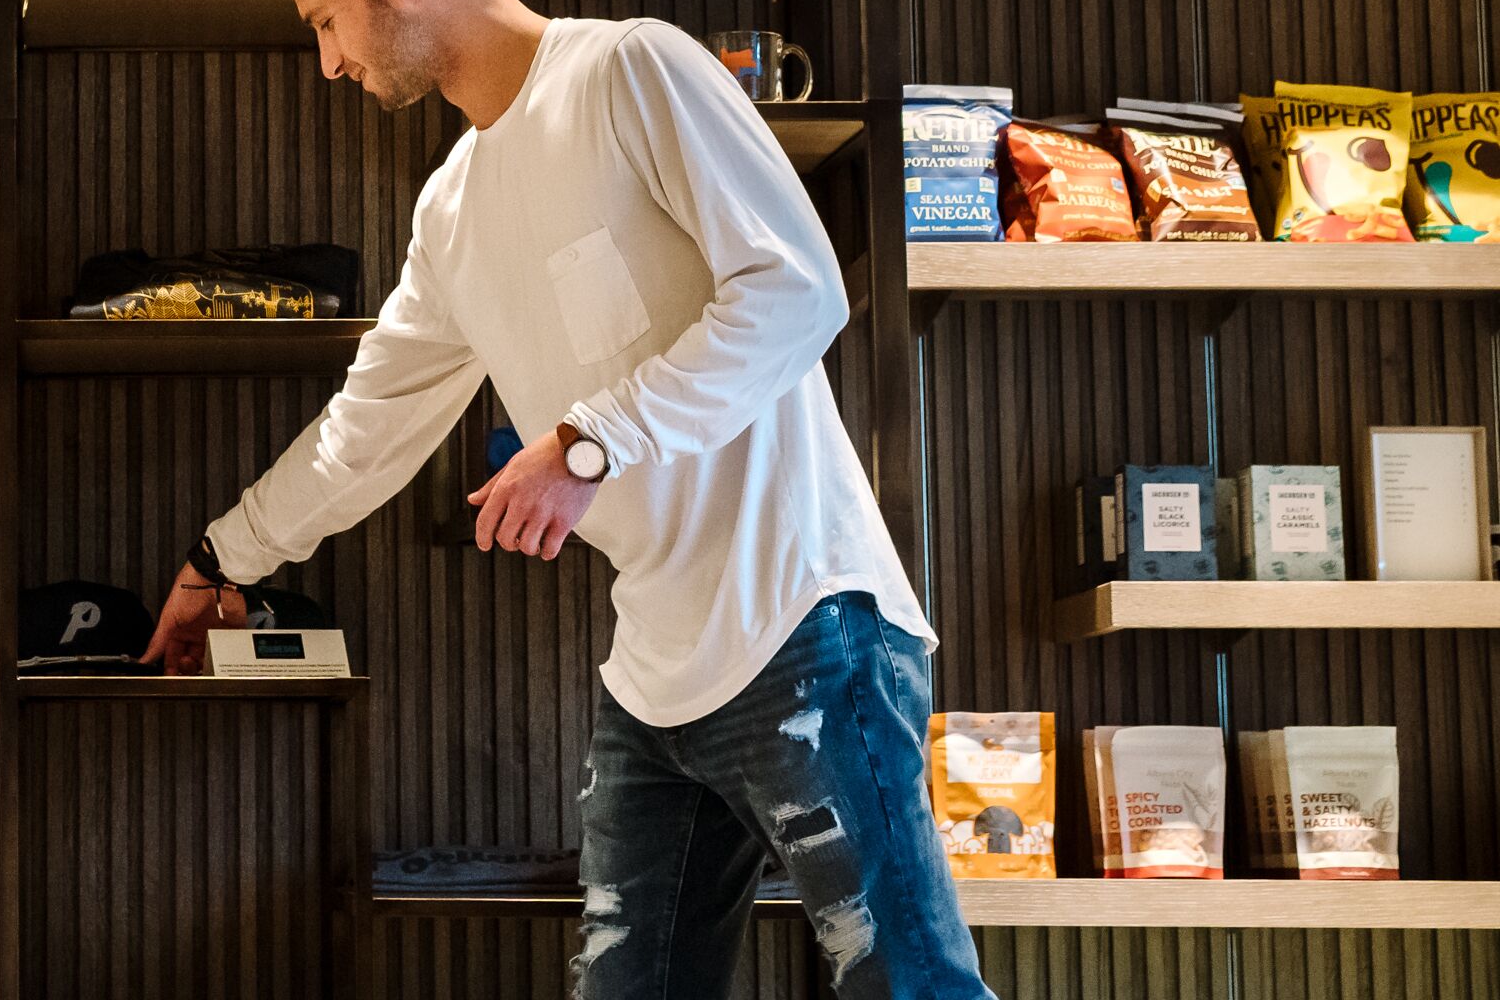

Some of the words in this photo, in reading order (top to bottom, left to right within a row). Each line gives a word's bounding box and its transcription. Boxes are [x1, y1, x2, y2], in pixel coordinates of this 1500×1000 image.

[1278, 102, 1392, 131] HIPPEAS
[1411, 103, 1500, 140] IPPEAS
[931, 144, 970, 154] BRAND
[904, 156, 957, 168] POTATO
[959, 156, 997, 169] CHIPS
[920, 194, 942, 204] SEA
[944, 194, 974, 204] SALT
[976, 194, 986, 204] &
[911, 206, 992, 220] VINEGAR
[59, 601, 100, 645] P
[1125, 792, 1160, 803] SPICY
[1300, 793, 1342, 803] SWEET
[1126, 804, 1183, 815] TOASTED
[1302, 806, 1311, 816] &
[1314, 804, 1355, 815] SALTY
[1127, 816, 1163, 828] CORN
[1304, 817, 1376, 829] HAZELNUTS
